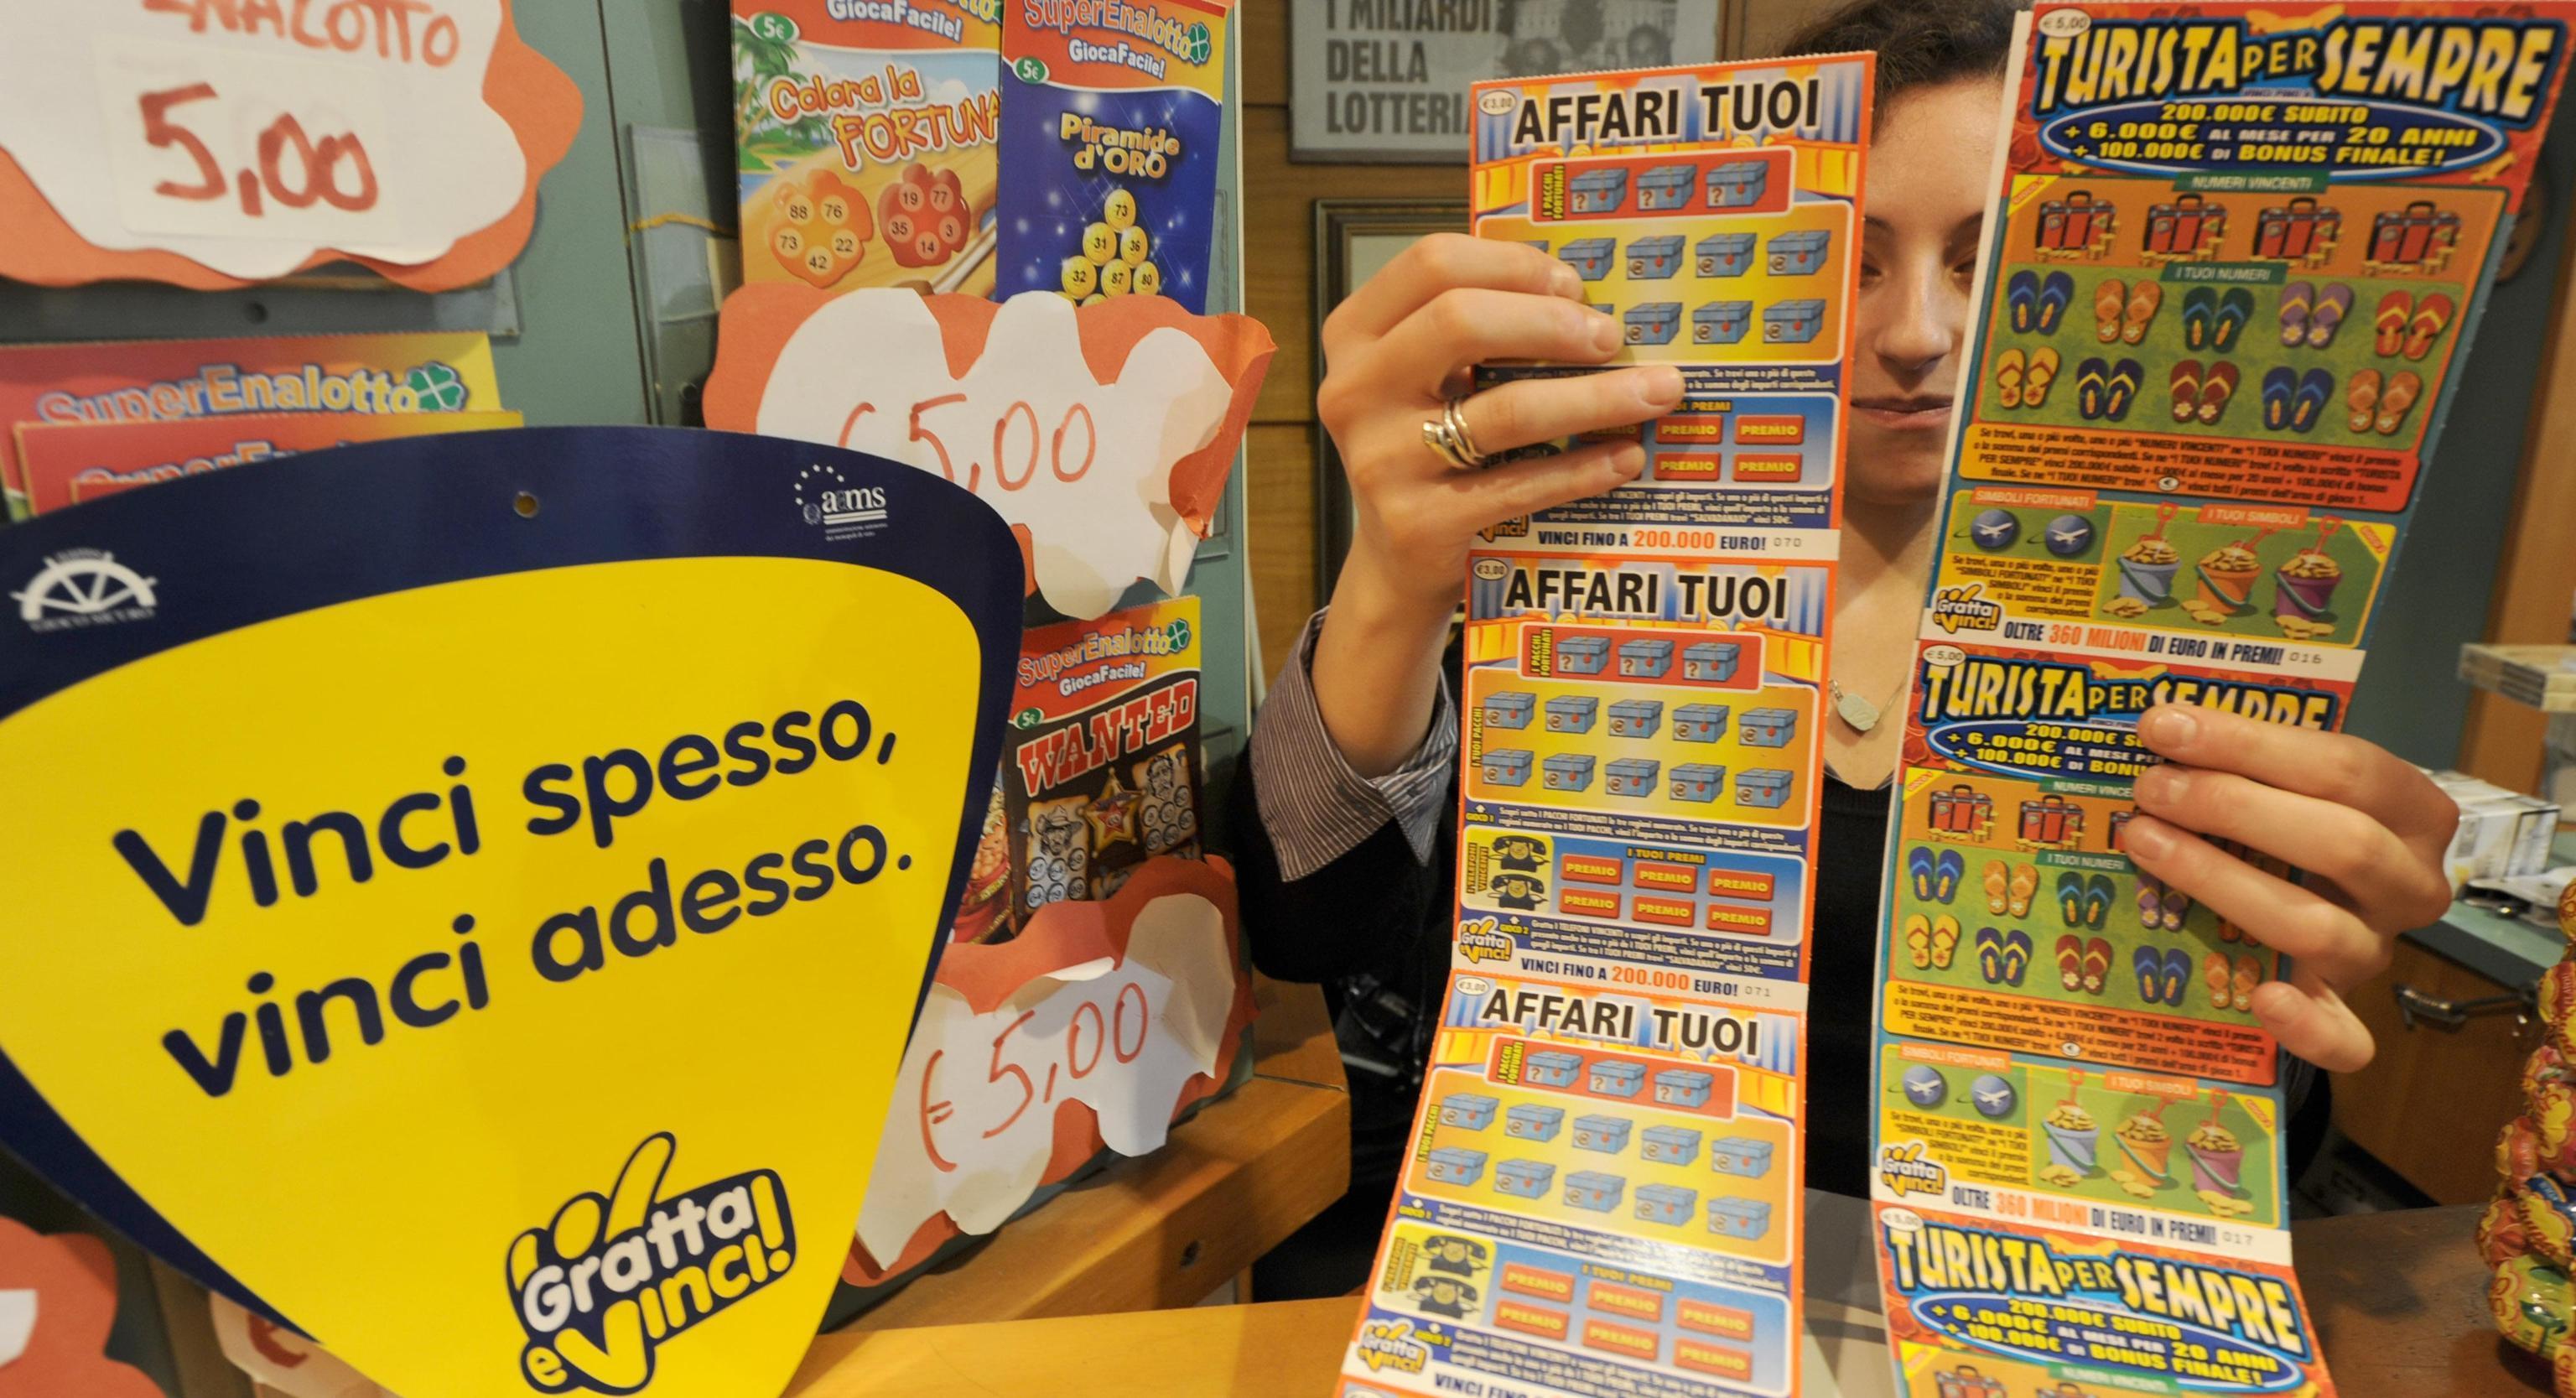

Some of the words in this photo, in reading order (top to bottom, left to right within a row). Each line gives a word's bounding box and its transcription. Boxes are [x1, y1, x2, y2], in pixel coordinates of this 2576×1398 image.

[141, 0, 460, 67] NALOTTO
[763, 16, 785, 39] 5€
[1022, 60, 1039, 80] 5€
[1069, 39, 1166, 80] GiocaFacile!
[1326, 40, 1428, 83] DELLA
[2039, 26, 2238, 111] TURISTA
[2241, 38, 2318, 78] PER
[2317, 25, 2556, 119] SEMPRE
[770, 74, 883, 120] Colora
[886, 65, 920, 101] la
[1326, 91, 1470, 134] LOTTERI
[1514, 90, 1679, 144] AFFARI
[1701, 79, 1820, 133] TUOI
[2161, 103, 2277, 122] 200.000€
[2283, 105, 2370, 124] SUBITO
[832, 90, 997, 168] FORTUNA
[1061, 112, 1181, 157] Piramide
[2088, 122, 2199, 141] 6.000€
[2209, 129, 2232, 142] AL
[2238, 129, 2292, 143] MESE
[2296, 130, 2336, 143] PER
[2346, 127, 2391, 144] 20
[2400, 127, 2479, 148] ANNI
[139, 82, 378, 218] 5,00
[1074, 143, 1167, 179] d'ORO
[2099, 142, 2205, 159] 100.000€
[2211, 148, 2231, 160] DI
[2238, 143, 2328, 163] BONUS
[902, 191, 918, 205] 19
[932, 190, 949, 204] 77
[2191, 175, 2247, 190] NUMERI
[2248, 176, 2313, 190] VINCENTI
[789, 205, 808, 221] 88
[823, 204, 844, 220] 76
[1115, 205, 1128, 217] 73
[780, 235, 799, 251] 73
[835, 238, 854, 253] 22
[891, 221, 909, 236] 35
[808, 255, 828, 270] 42
[2184, 267, 2216, 279] TUOI
[2217, 268, 2272, 282] NUMERI
[1661, 424, 1718, 436] PREMIO
[1740, 424, 1799, 436] PREMIO
[1660, 461, 1716, 471] PREMIO
[1738, 461, 1796, 472] PREMIO
[1975, 490, 2023, 502] SIMBOLI
[2025, 492, 2090, 507] FORTUNATI
[1538, 530, 1579, 545] VINCI
[1582, 532, 1616, 546] FINO
[1619, 533, 1629, 547] A
[1633, 529, 1716, 549] 200.000
[1720, 535, 1766, 550] EURO!
[1504, 568, 1659, 614] AFFARI
[1680, 575, 1787, 619] TUOI
[1938, 599, 1993, 616] Gratta
[1017, 627, 1171, 688] SuperEnalotto
[2004, 621, 2045, 642] OLTRE
[2049, 624, 2083, 646] 360
[2085, 627, 2147, 652] MILIONI
[2148, 635, 2166, 654] DI
[2168, 637, 2207, 658] EURO
[2211, 642, 2229, 661] IN
[2231, 643, 2286, 665] PREMI!
[1059, 661, 1146, 698] GiocaFacile!
[1925, 661, 2085, 719] TURISTA
[2088, 685, 2149, 710] PER
[1017, 678, 1197, 798] WANTED
[1967, 731, 2056, 754] 6.000€
[2064, 746, 2083, 756] AL
[2089, 748, 2131, 761] MESE
[2025, 723, 2117, 745] 200.000€
[1976, 747, 2062, 769] 100.000€
[2068, 760, 2084, 771] DI
[2090, 759, 2148, 777] BONU
[2053, 780, 2097, 794] NUMERI
[112, 755, 481, 928] Vinci
[522, 699, 897, 849] spesso,
[1636, 849, 1665, 860] TUOI
[1667, 852, 1706, 864] PREMI
[2081, 855, 2126, 871] NUMERI
[1566, 863, 1618, 877] PREMIO
[1639, 871, 1693, 886] PREMIO
[1713, 878, 1769, 893] PREMIO
[1564, 895, 1616, 910] PREMIO
[1637, 903, 1691, 918] PREMIO
[1711, 911, 1767, 927] PREMIO
[1462, 932, 1506, 948] Gratta
[163, 913, 491, 1098] vinci
[530, 824, 914, 982] adesso.
[1521, 957, 1560, 974] VINCI
[1563, 962, 1595, 979] FINO
[1597, 967, 1607, 980] A
[1611, 965, 1690, 990] 200.000
[1694, 979, 1739, 996] EURO!
[1483, 989, 1634, 1040] AFFARI
[1653, 1007, 1759, 1056] TUOI
[984, 982, 1148, 1139] 5,00
[1952, 1186, 1991, 1209] OLTRE
[2110, 1209, 2146, 1235] EURO
[523, 1185, 755, 1333] Gratta
[1888, 1225, 2064, 1296] TURISTA
[2053, 1260, 2117, 1290] PER
[2114, 1256, 2304, 1354] SEMPRE
[2111, 1315, 2182, 1341] SUBITO
[525, 1346, 569, 1388] e
[2089, 1343, 2168, 1370] BONUS
[2170, 1341, 2209, 1360] 20
[2215, 1348, 2279, 1373] ANNI
